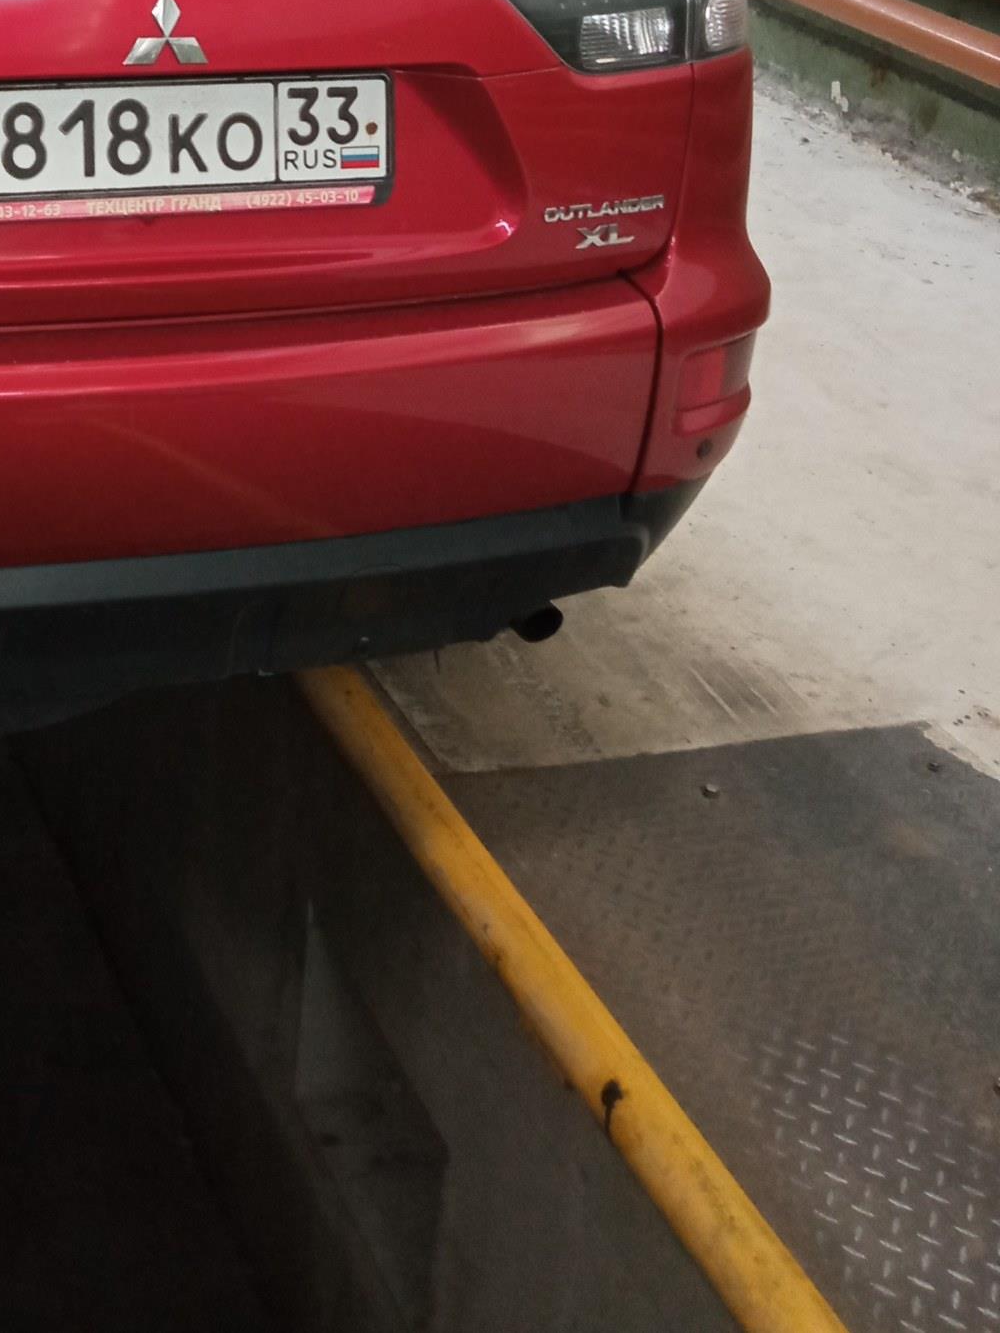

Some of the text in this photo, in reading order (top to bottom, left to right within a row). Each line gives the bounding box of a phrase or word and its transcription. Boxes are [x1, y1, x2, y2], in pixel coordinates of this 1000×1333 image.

[286, 87, 359, 145] 33
[284, 149, 338, 170] RUS
[544, 195, 665, 223] OUTLANDER
[576, 223, 635, 249] XL
